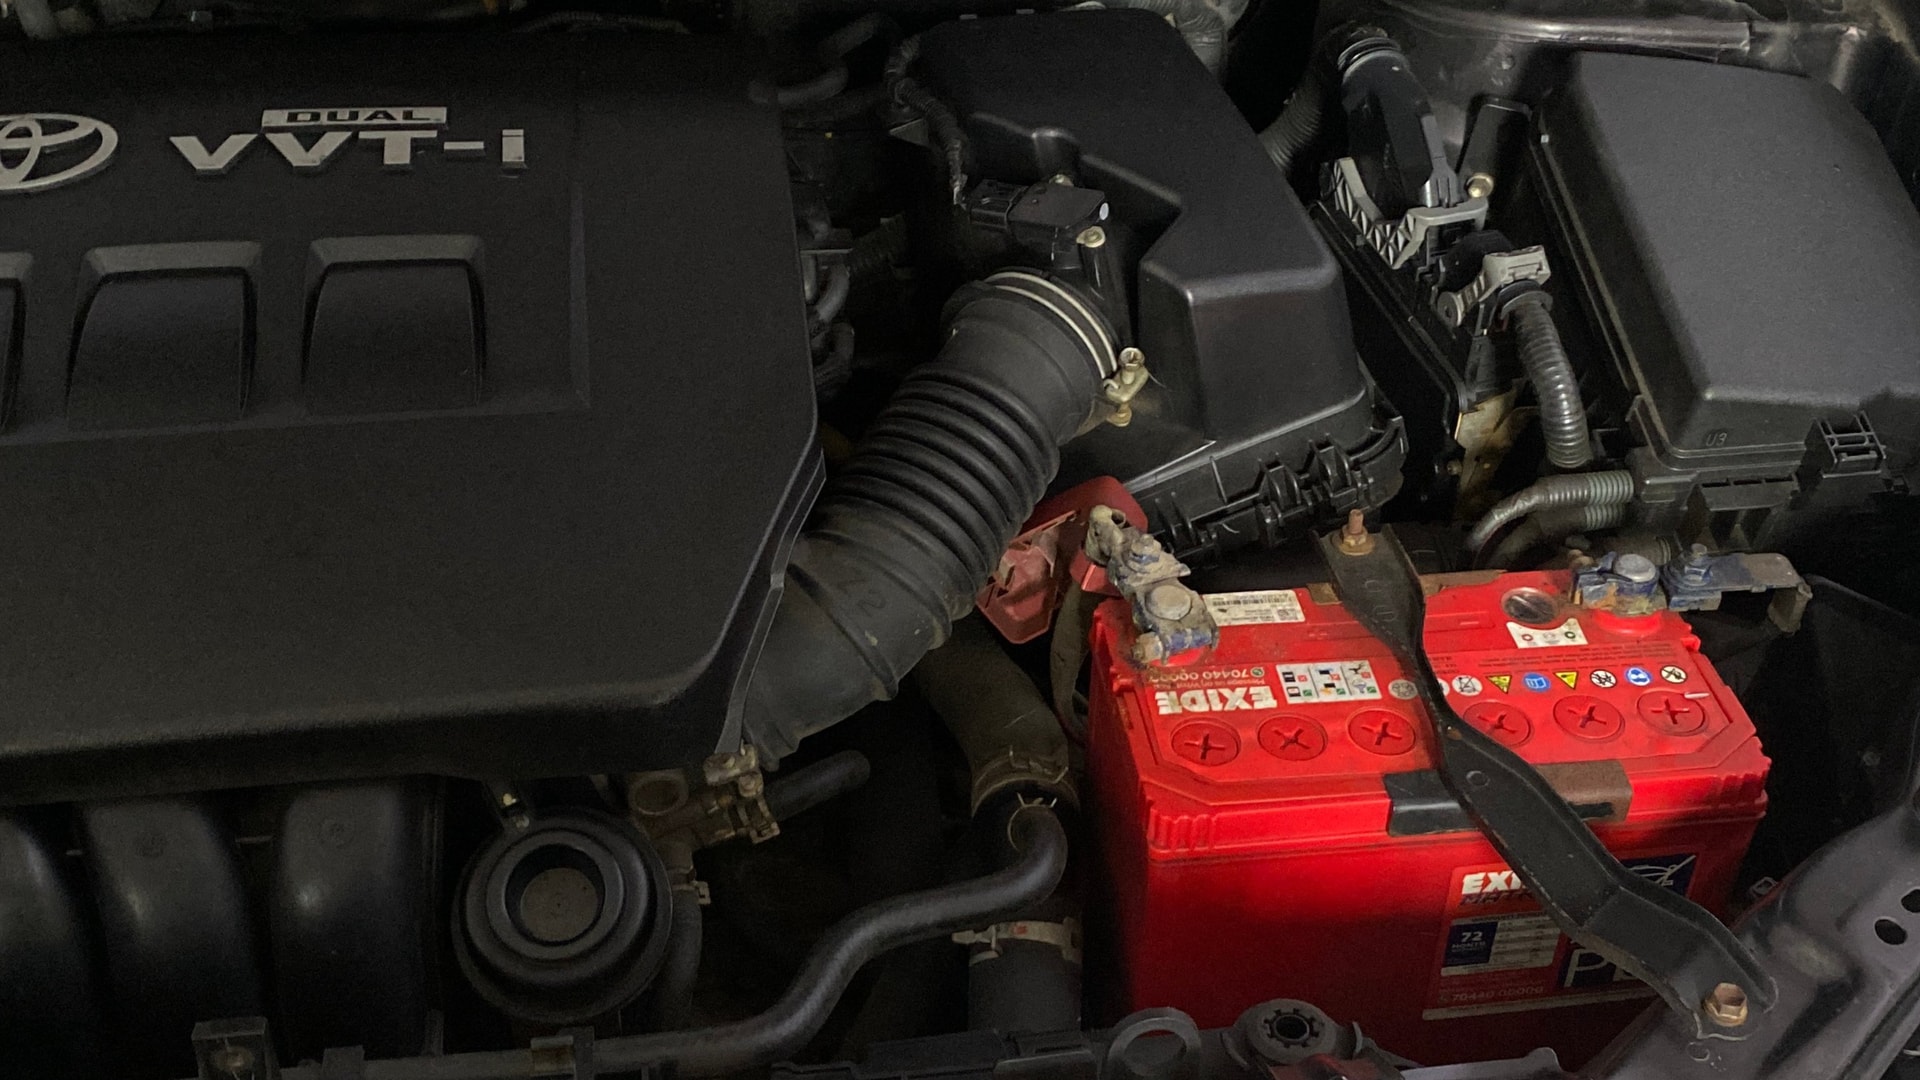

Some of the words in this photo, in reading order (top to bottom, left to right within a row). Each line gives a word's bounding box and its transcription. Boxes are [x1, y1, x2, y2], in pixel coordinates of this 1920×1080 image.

[286, 108, 431, 123] DUAL
[1202, 669, 1249, 680] 70440
[1155, 685, 1278, 715] EXIDE
[1461, 870, 1527, 895] EXI
[1461, 931, 1483, 943] 72
